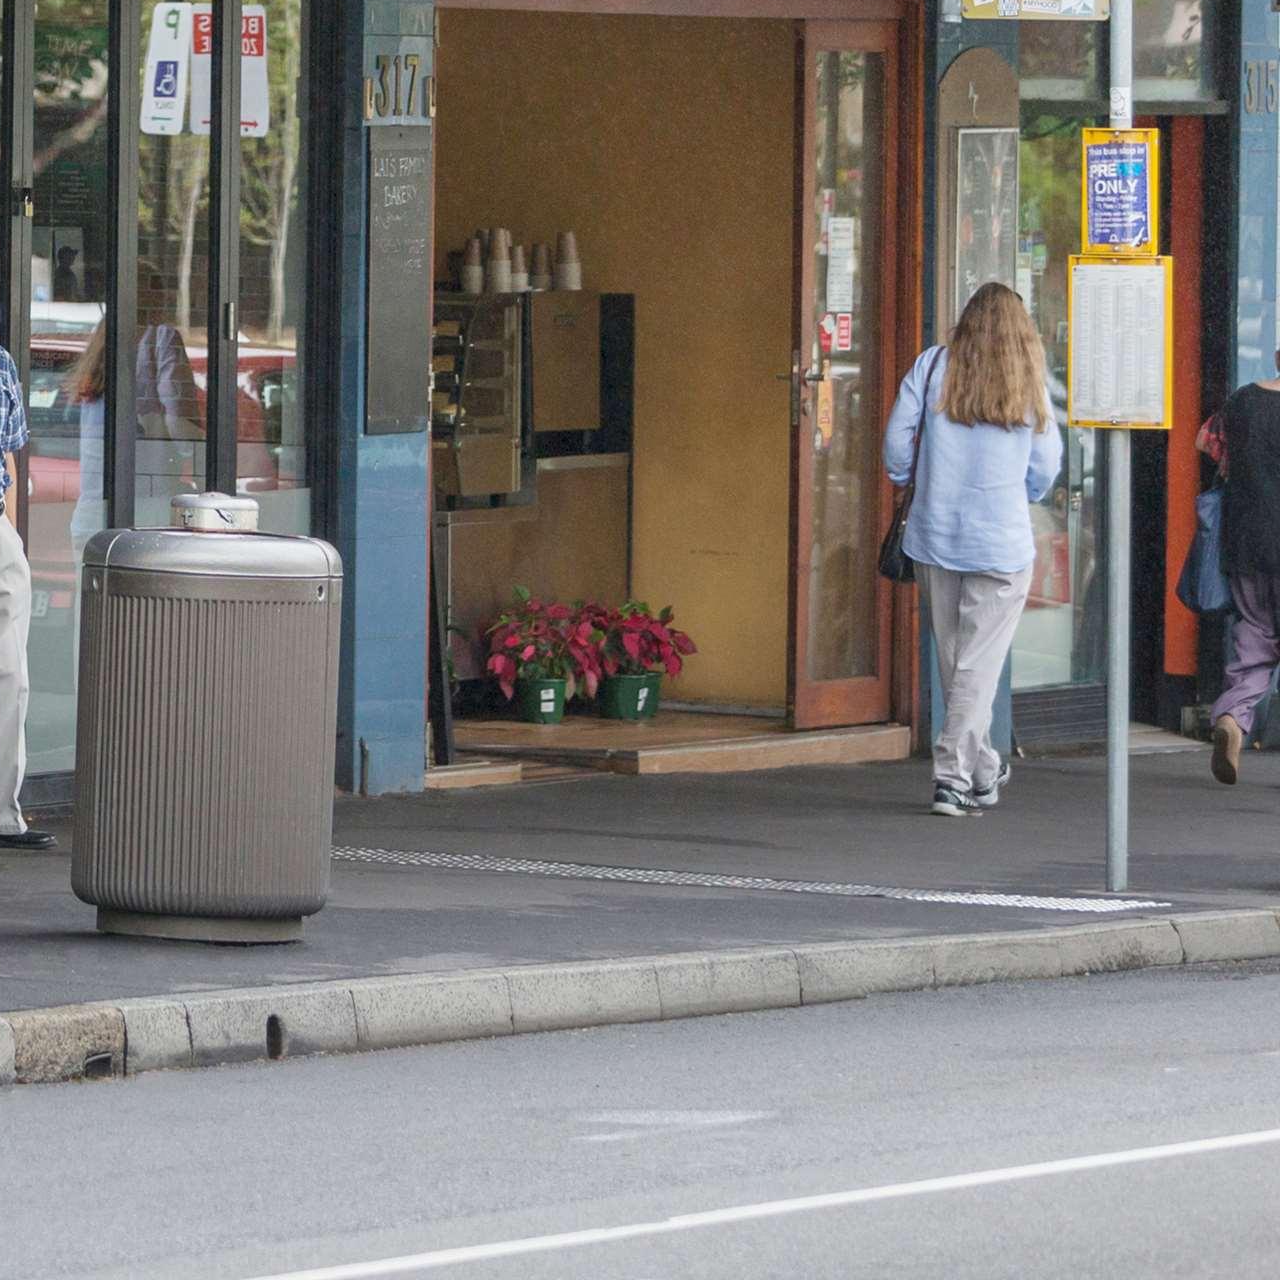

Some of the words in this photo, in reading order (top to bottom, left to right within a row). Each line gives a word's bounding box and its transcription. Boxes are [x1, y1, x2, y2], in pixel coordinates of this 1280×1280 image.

[375, 54, 421, 119] 317
[1243, 59, 1279, 114] 315
[1095, 179, 1138, 194] ONLY
